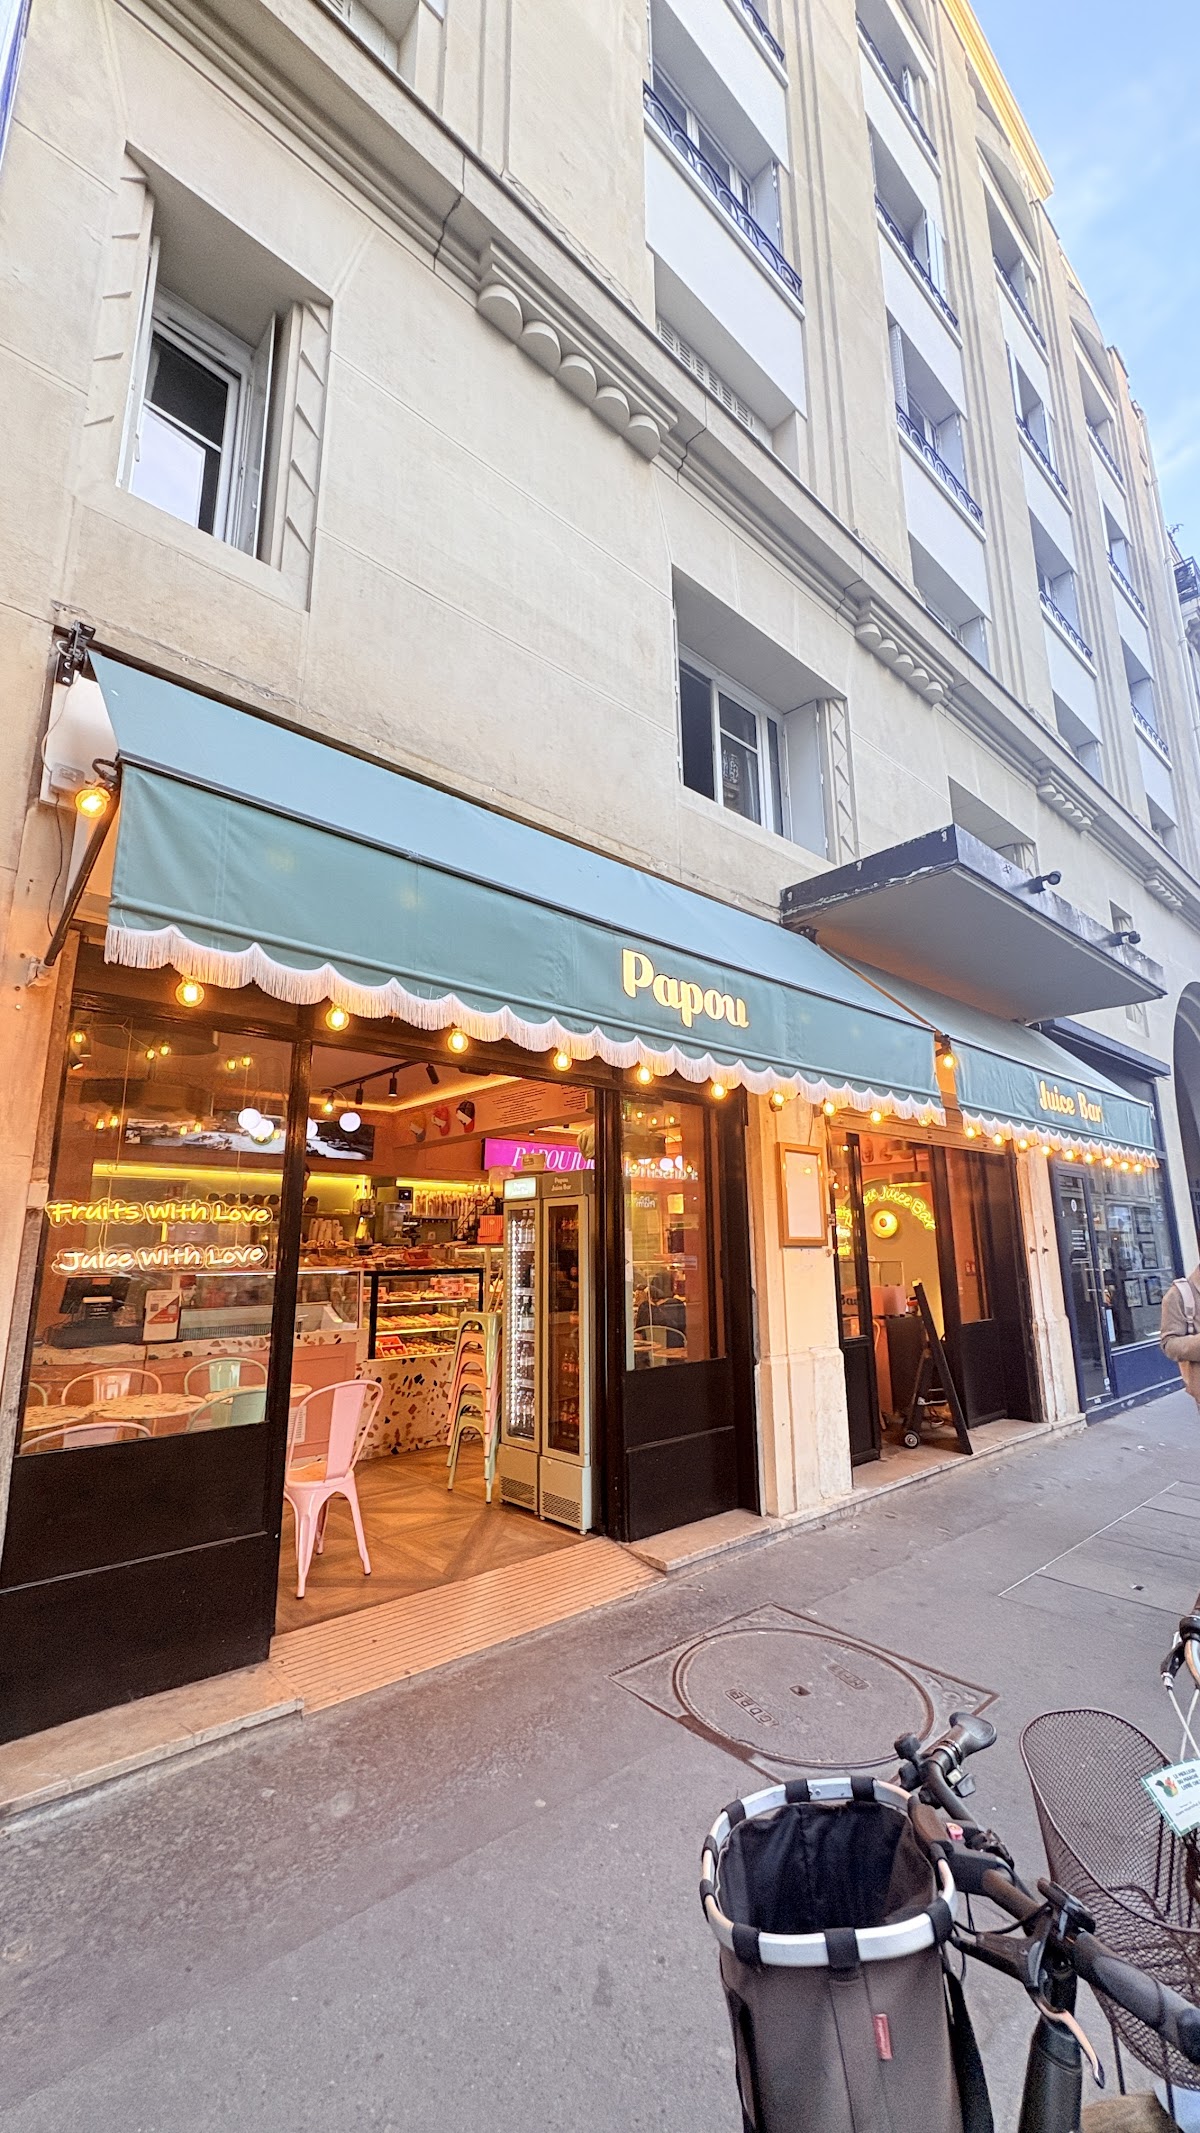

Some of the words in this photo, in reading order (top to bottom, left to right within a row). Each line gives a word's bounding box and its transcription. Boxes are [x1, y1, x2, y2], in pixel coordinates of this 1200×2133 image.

[622, 949, 749, 1028] Papou
[1040, 1080, 1075, 1115] Juice
[1077, 1091, 1104, 1122] Bar
[52, 1203, 140, 1223] Fruits
[213, 1204, 270, 1222] Love
[59, 1251, 135, 1271] Juice
[207, 1246, 264, 1266] Love
